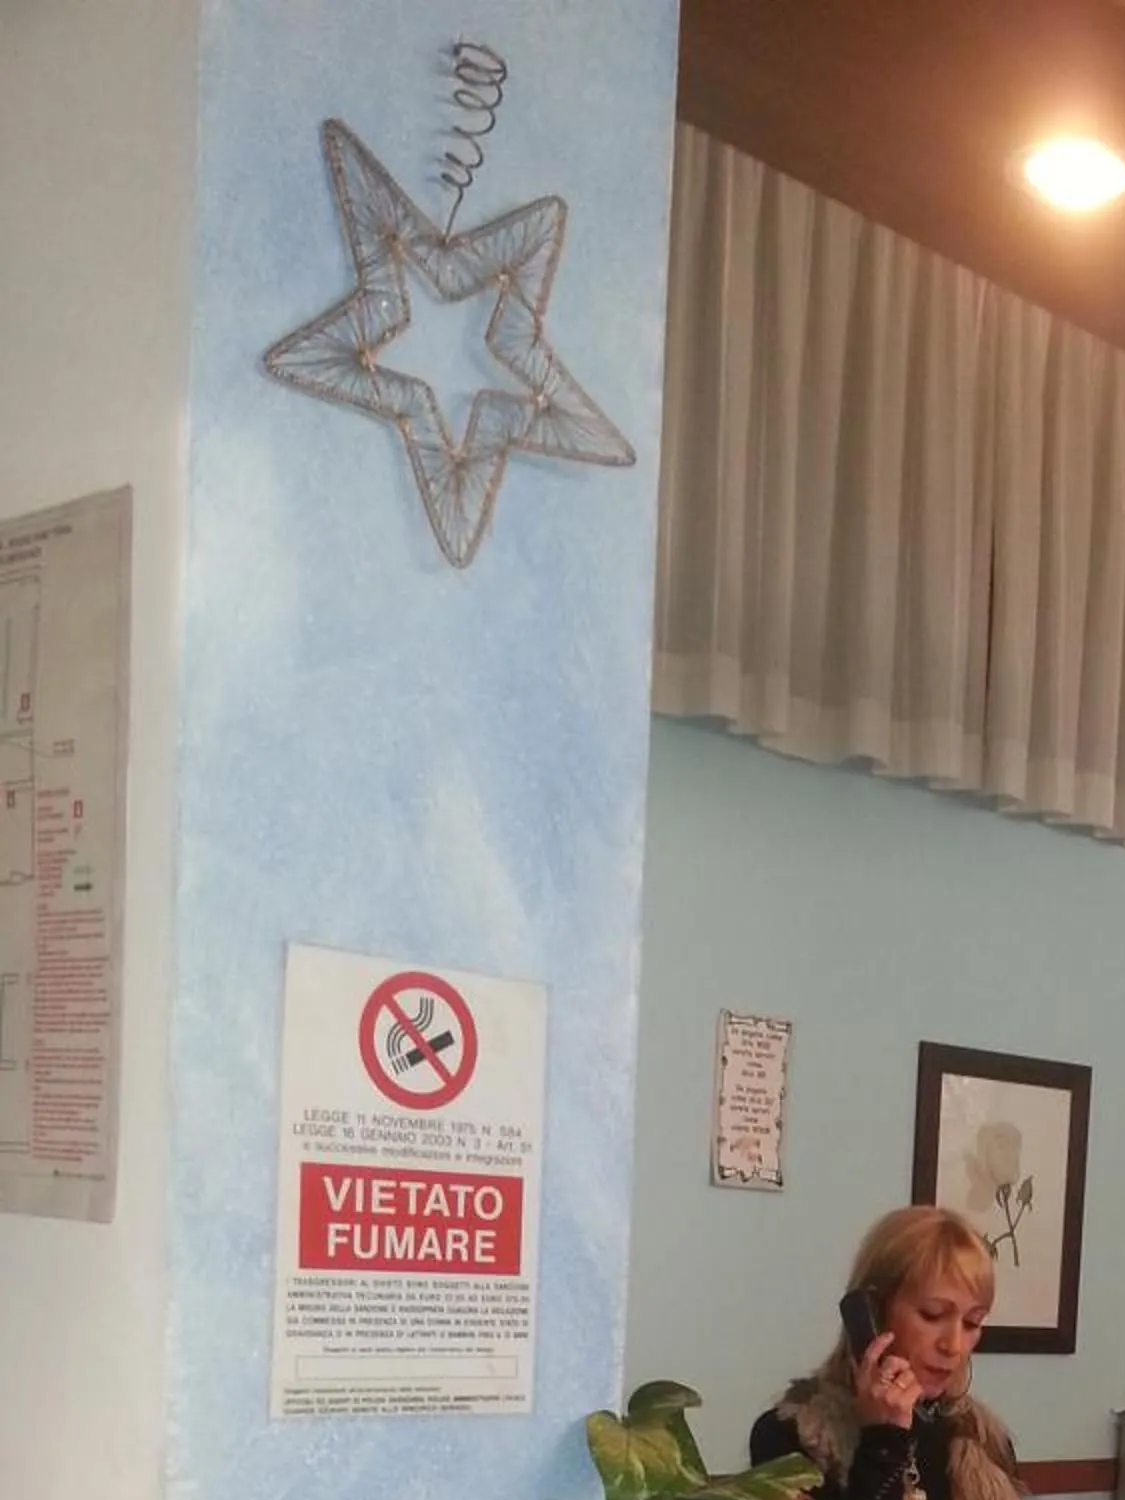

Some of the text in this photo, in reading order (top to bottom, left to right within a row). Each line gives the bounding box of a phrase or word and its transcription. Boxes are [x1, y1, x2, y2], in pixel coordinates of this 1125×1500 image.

[292, 1123, 336, 1138] LEGGE
[303, 1109, 349, 1124] LEGGE
[372, 1113, 444, 1132] NOVEMBRE
[323, 1176, 504, 1221] VIETATO
[327, 1223, 497, 1264] FUMARE
